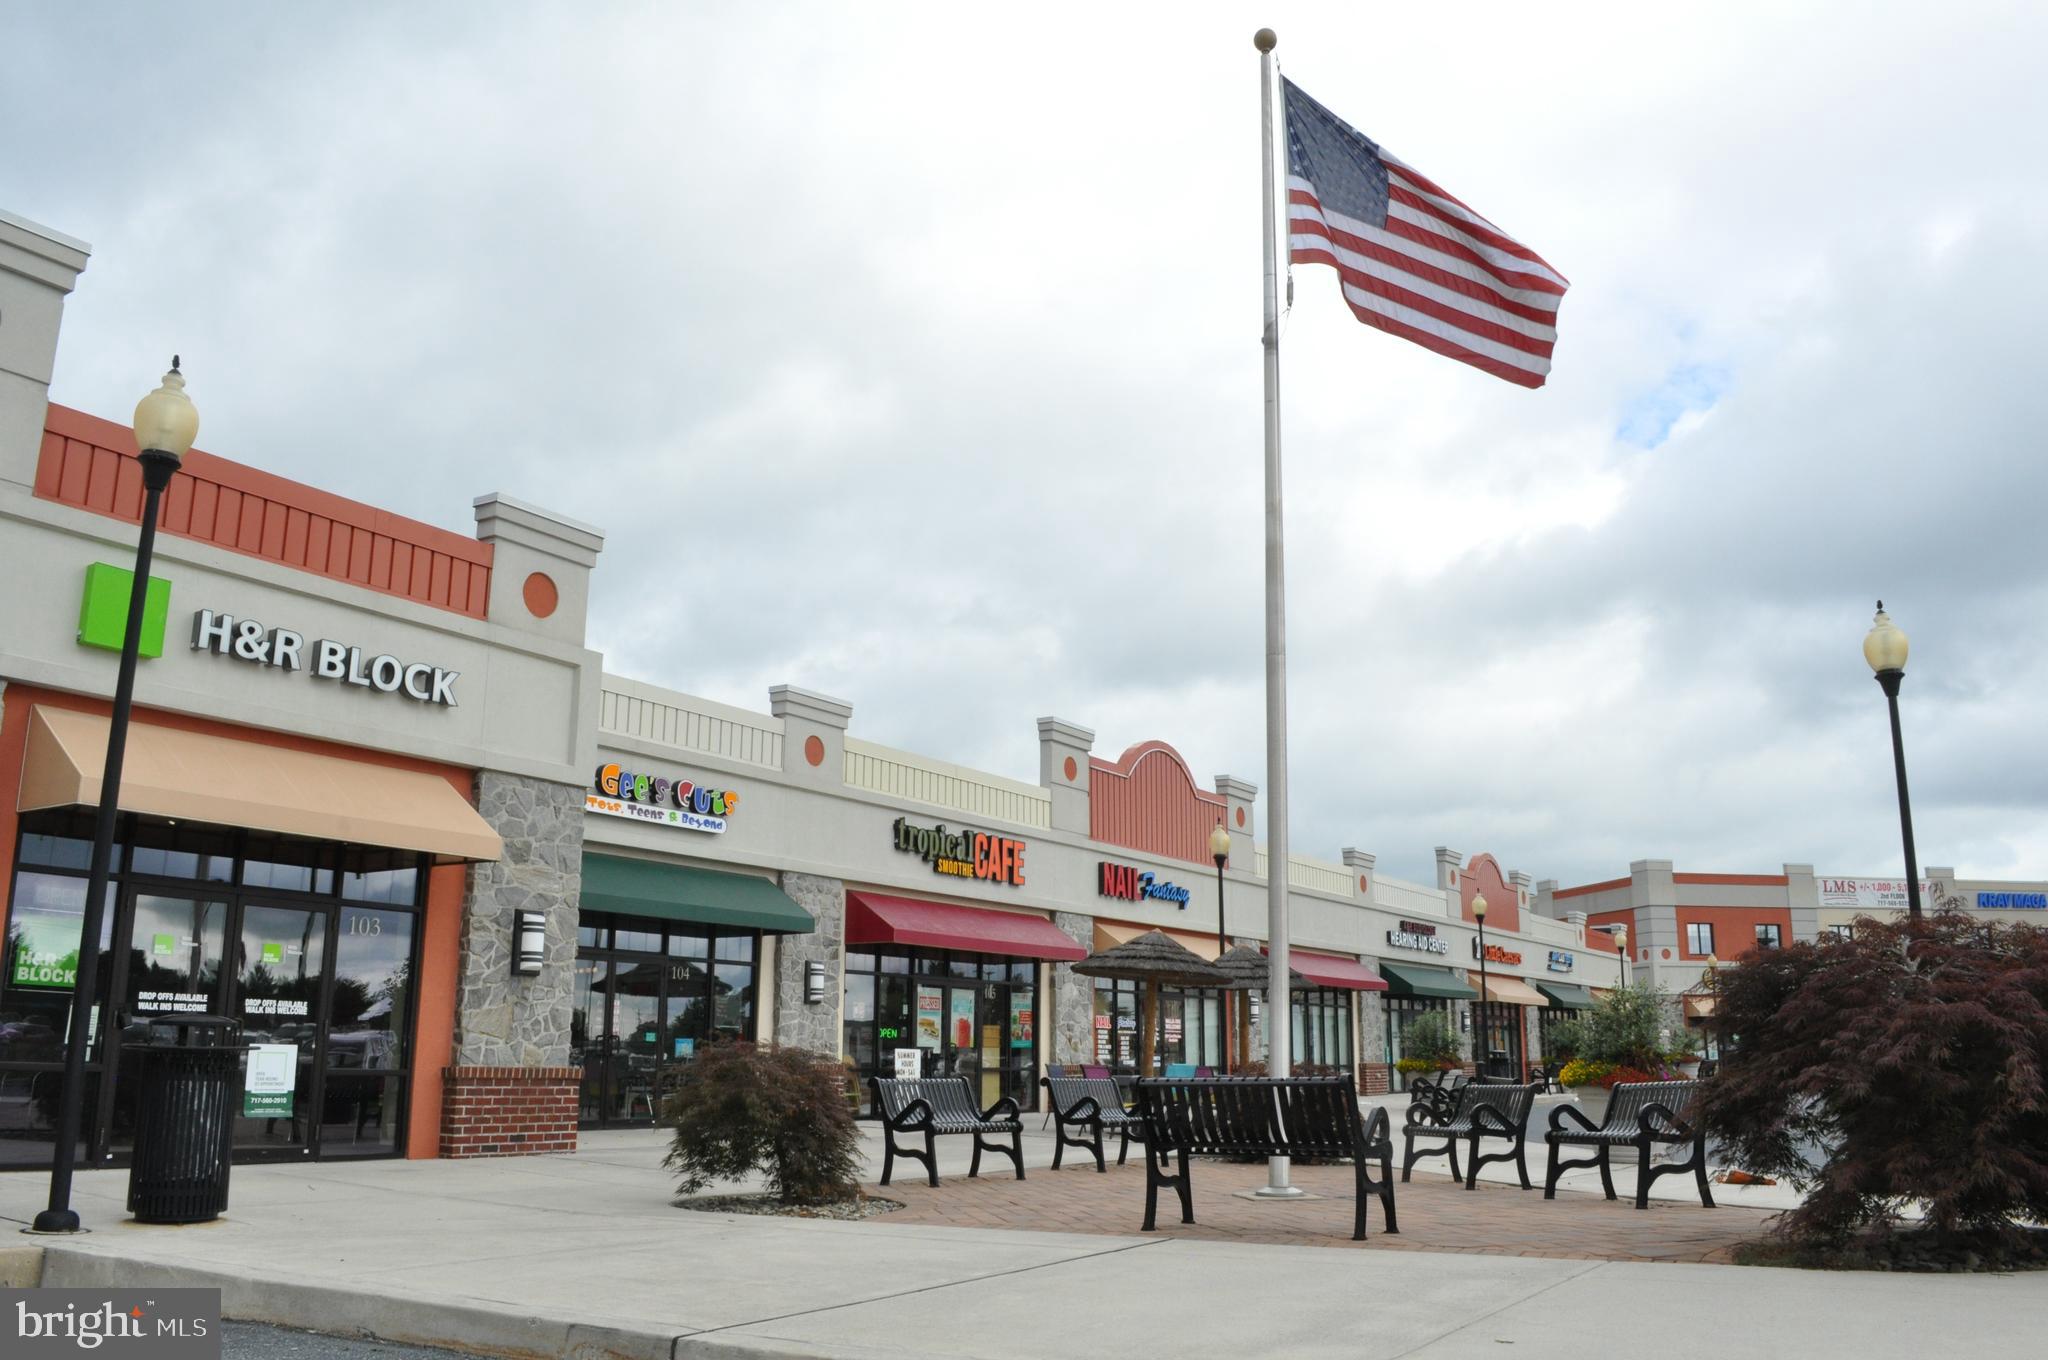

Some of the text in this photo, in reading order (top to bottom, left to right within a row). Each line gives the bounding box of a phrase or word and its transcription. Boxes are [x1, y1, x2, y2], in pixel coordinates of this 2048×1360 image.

[192, 609, 461, 707] H&R BLOCK
[595, 762, 671, 802] Gee's
[627, 804, 665, 820] Teens
[669, 811, 679, 823] &
[681, 813, 723, 830] Beyond
[894, 816, 1026, 886] tropical CAFE
[937, 858, 975, 878] SMOOTHIE
[1099, 862, 1190, 910] NAIL Fantasy
[1822, 879, 1857, 894] LMS
[1977, 893, 2047, 908] KRAV MAGA
[350, 915, 381, 937] 103
[1389, 930, 1449, 953] HEARING AID CENTER
[17, 950, 77, 984] H&R BLOCK
[671, 966, 690, 980] 104
[138, 992, 208, 1002] DROP OFFS AVAILABLE
[138, 1002, 207, 1012] WALK INS WELCOME
[245, 999, 308, 1009] DROP OFFS AVAILABLE
[277, 1007, 308, 1015] WELCOME
